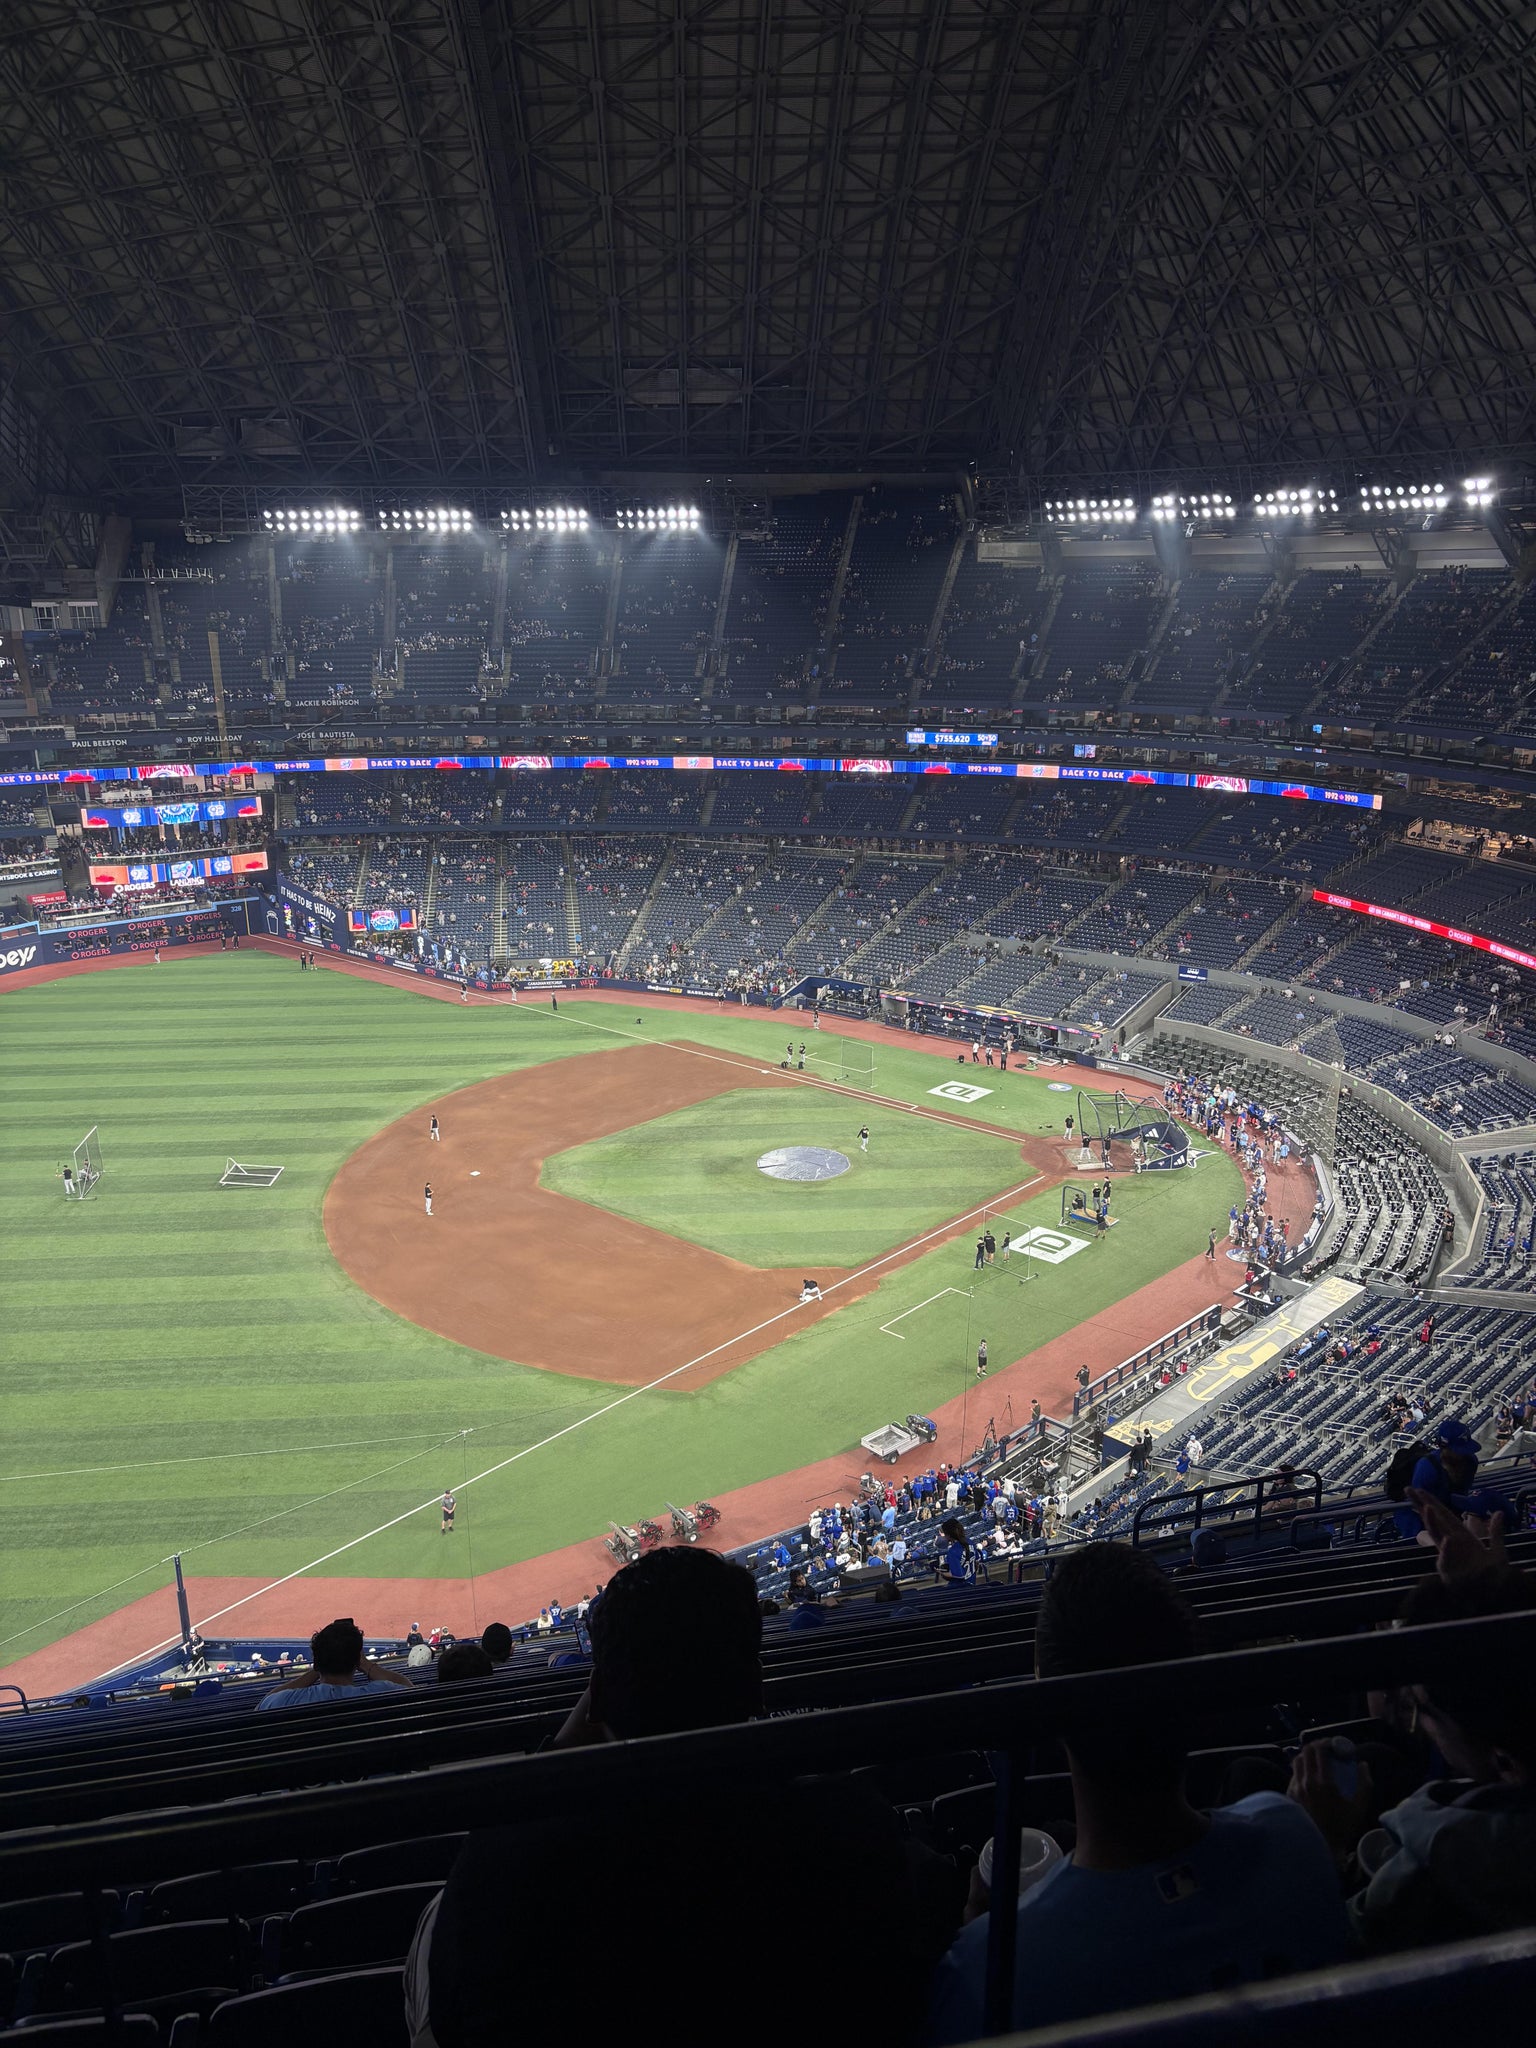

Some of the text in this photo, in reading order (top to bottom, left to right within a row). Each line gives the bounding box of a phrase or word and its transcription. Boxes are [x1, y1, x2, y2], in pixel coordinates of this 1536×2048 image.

[93, 739, 128, 747] BEESTON
[934, 734, 970, 743] $755,620
[753, 760, 775, 768] BACK
[18, 774, 32, 782] TO
[35, 773, 60, 781] BACK
[1062, 769, 1124, 779] BACK TO BACK
[1324, 791, 1359, 803] 1992 1993
[34, 869, 57, 877] CASINO
[124, 882, 156, 892] ROGERS
[286, 889, 298, 902] HAS
[297, 895, 305, 906] TO
[305, 899, 313, 910] BE
[314, 902, 337, 923] HEINZ
[193, 912, 222, 921] ROGERS
[137, 919, 166, 929] ROGERS
[77, 927, 108, 937] ROGERS
[1454, 932, 1473, 943] ROGERS
[139, 939, 169, 949] ROGERS
[80, 947, 111, 958] ROGERS
